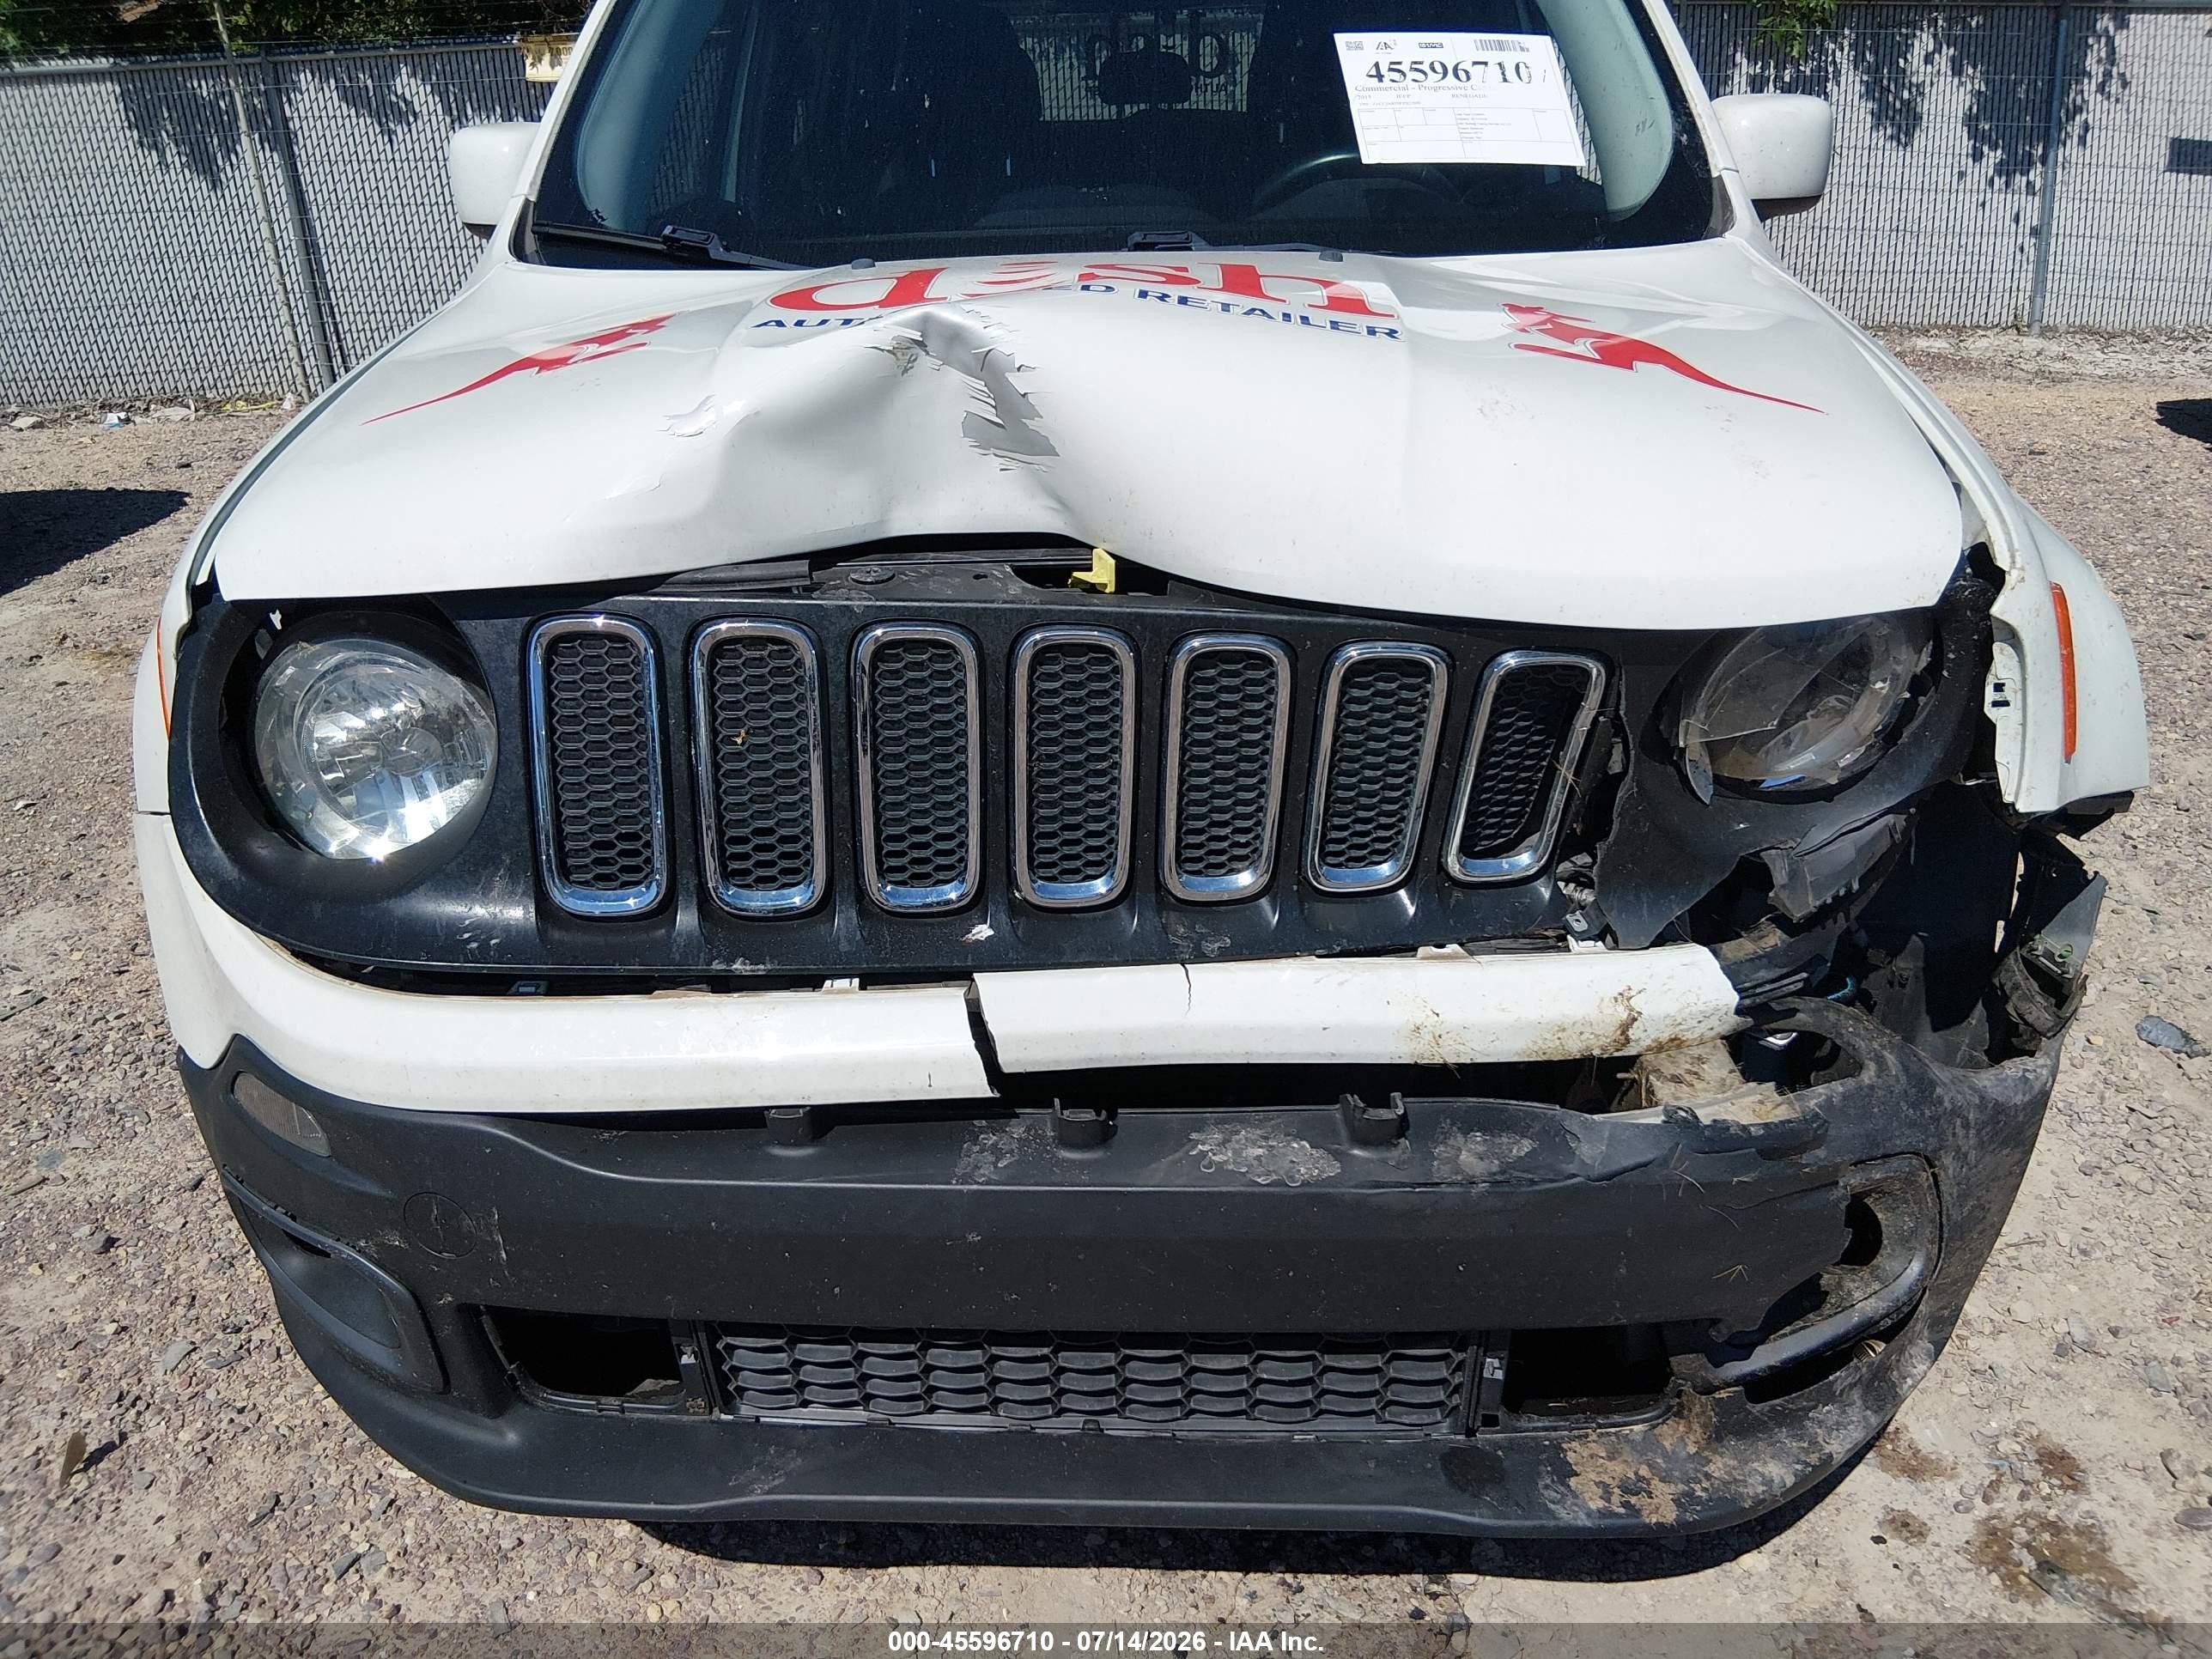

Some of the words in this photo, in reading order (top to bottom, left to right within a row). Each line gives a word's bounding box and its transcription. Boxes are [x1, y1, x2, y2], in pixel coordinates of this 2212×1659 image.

[1365, 59, 1532, 84] 45596710
[1418, 84, 1469, 93] Progressive
[1136, 289, 1403, 340] RETAILER
